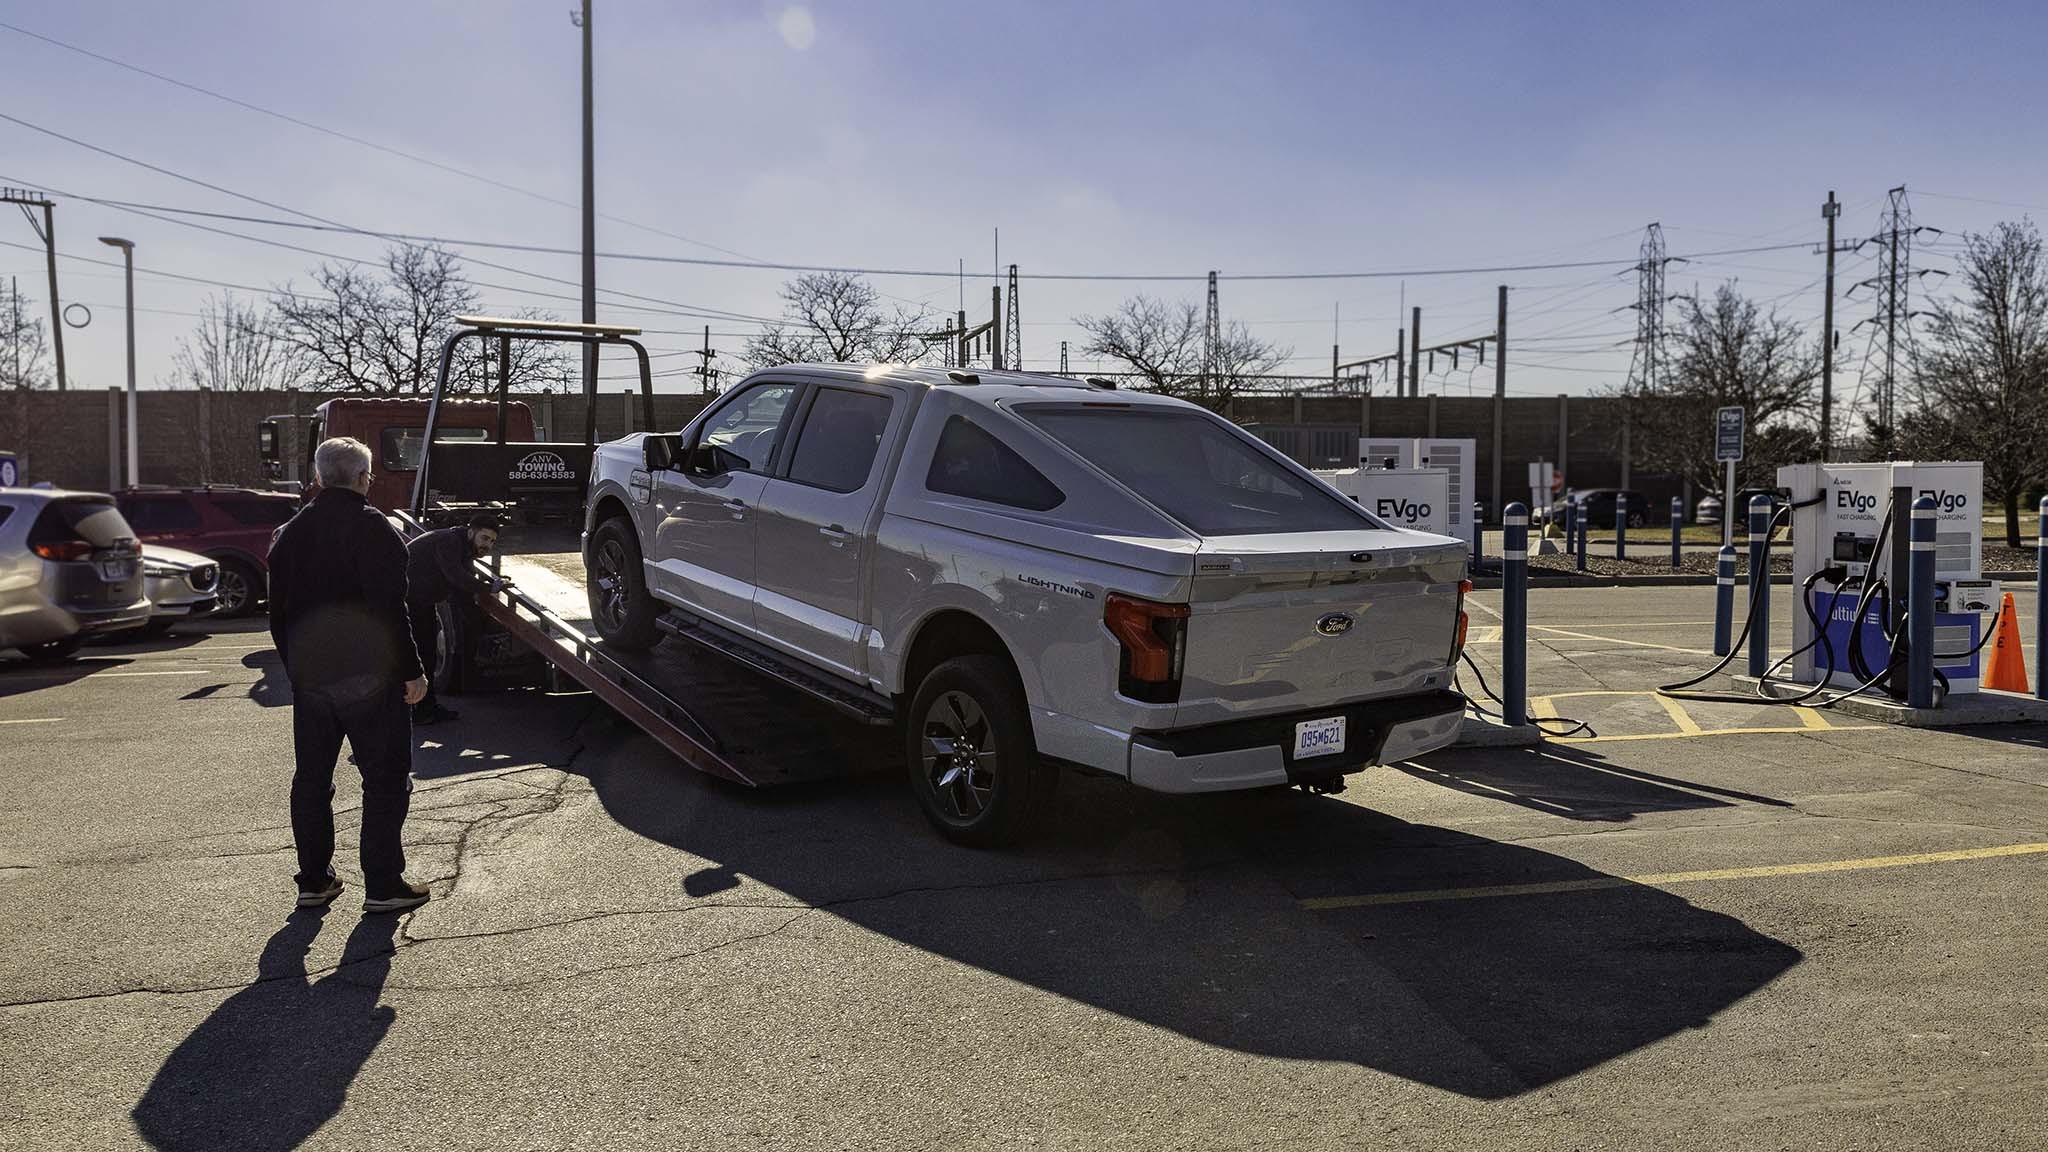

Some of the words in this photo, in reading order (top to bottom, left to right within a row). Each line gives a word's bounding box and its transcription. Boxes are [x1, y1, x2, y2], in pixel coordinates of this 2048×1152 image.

[531, 455, 553, 463] ANV
[517, 462, 566, 471] TOWING
[508, 471, 575, 479] 586-636-5583
[1837, 491, 1877, 512] EVgo
[1377, 499, 1431, 523] EVgo
[1836, 513, 1849, 521] FAST
[1850, 513, 1877, 521] CHARGING
[1018, 574, 1096, 599] LIGHTNING
[1326, 617, 1350, 631] Ford
